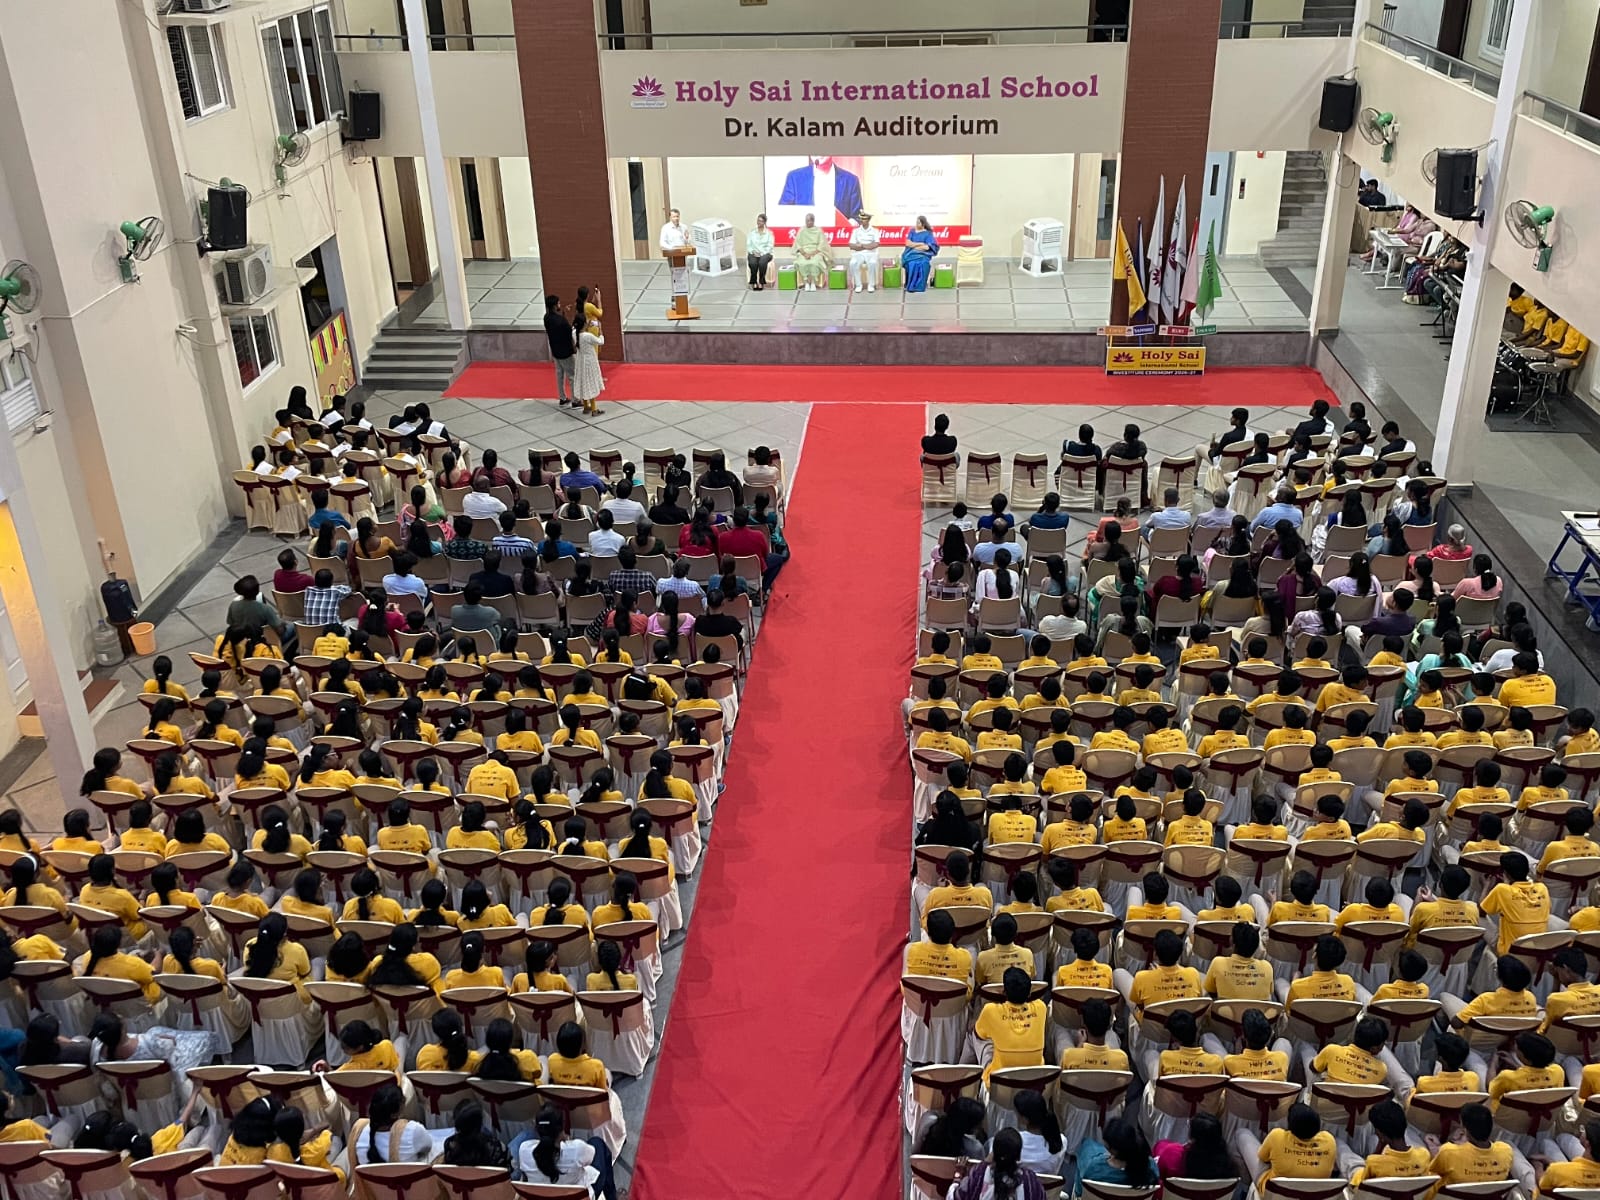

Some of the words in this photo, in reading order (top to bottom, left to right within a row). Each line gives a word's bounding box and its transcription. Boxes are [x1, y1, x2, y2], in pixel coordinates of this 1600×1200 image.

[675, 80, 739, 107] Holy
[749, 80, 792, 101] Sai
[801, 77, 990, 100] International
[1001, 74, 1098, 98] School
[725, 117, 758, 137] Dr.
[767, 117, 844, 136] Kalam
[854, 115, 998, 136] Auditorium
[836, 227, 850, 239] the
[1141, 351, 1173, 361] Holy
[1178, 351, 1200, 360] Sai
